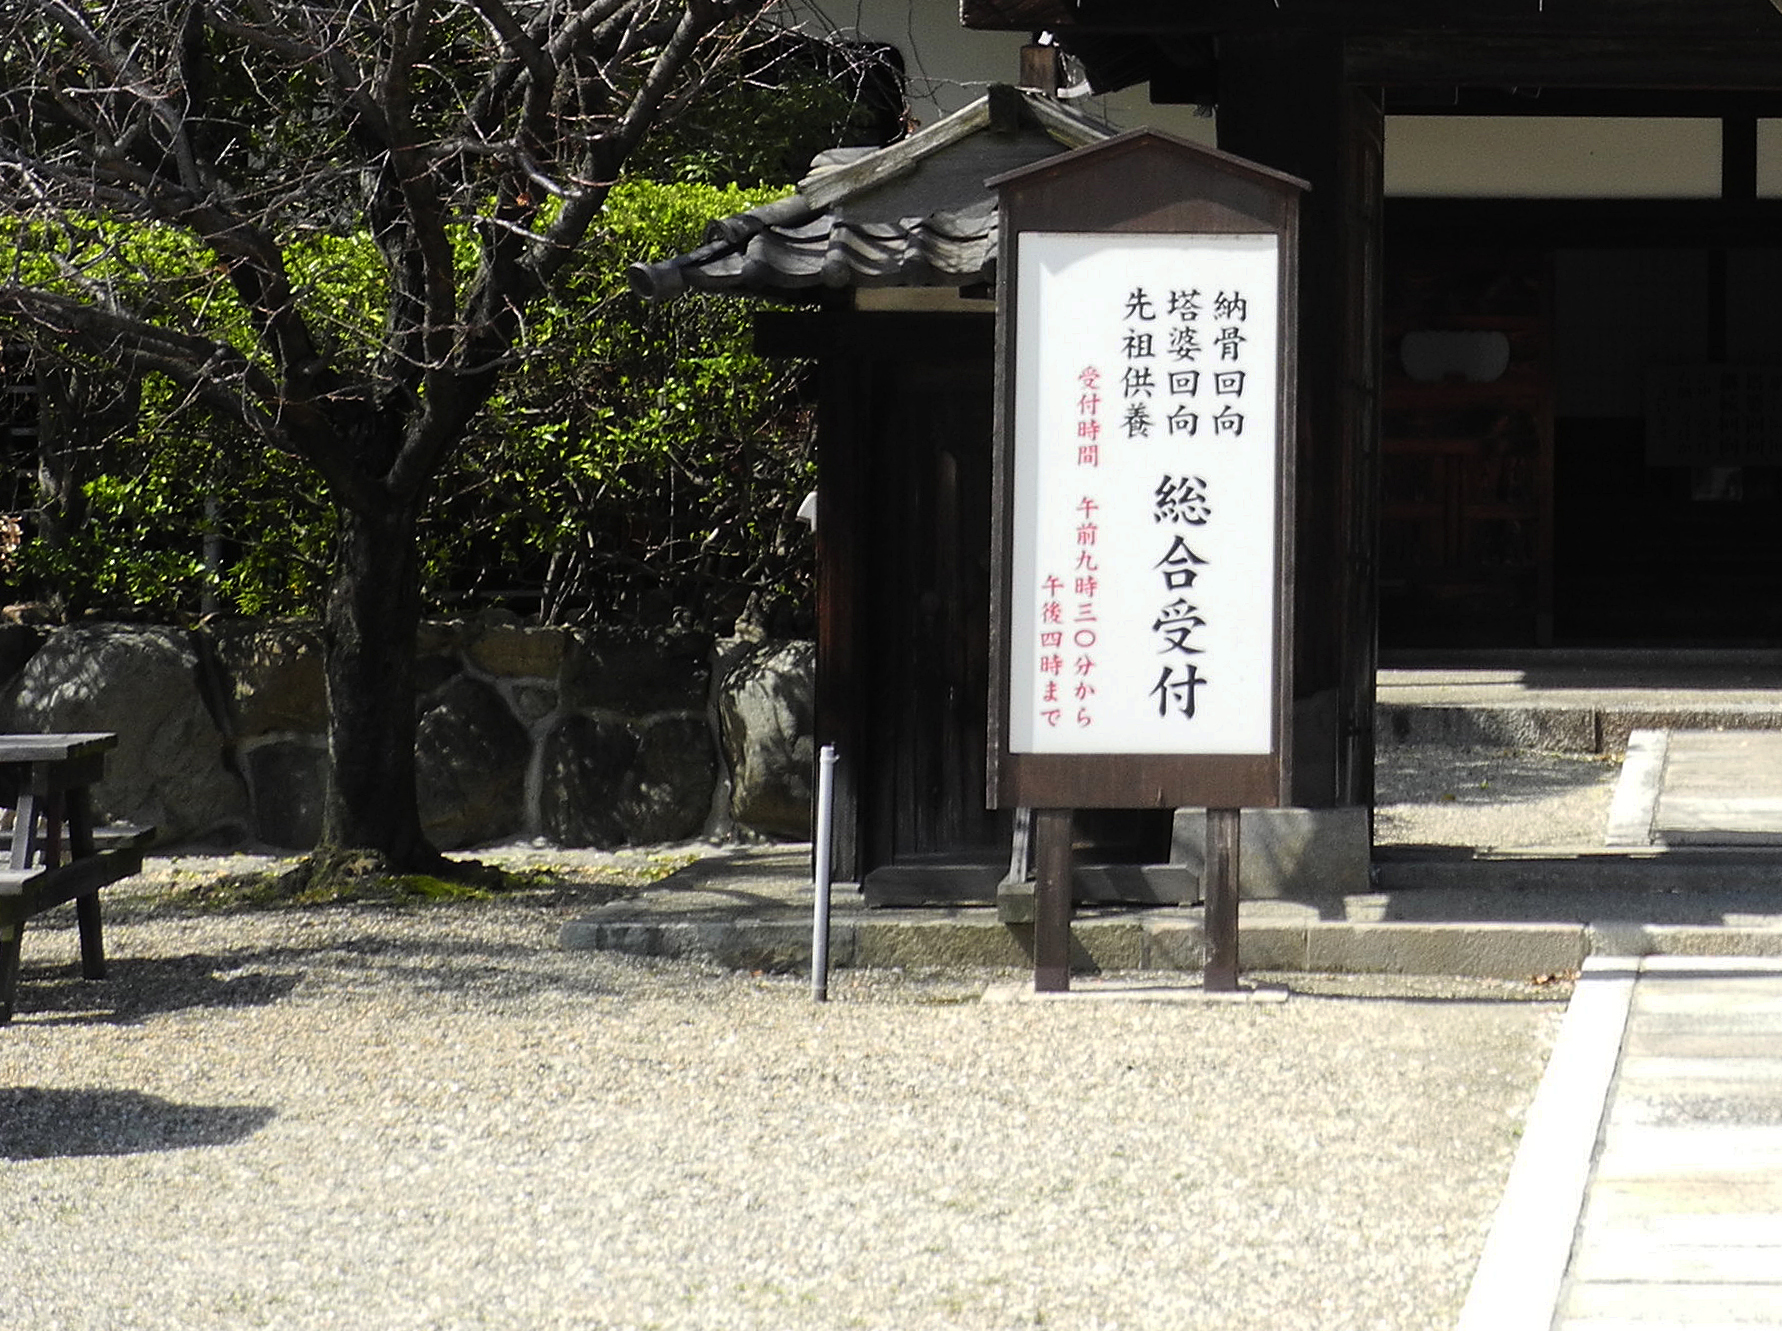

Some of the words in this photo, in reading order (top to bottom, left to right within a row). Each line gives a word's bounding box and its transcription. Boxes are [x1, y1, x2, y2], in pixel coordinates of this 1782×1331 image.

[1077, 368, 1103, 467] 受付時間
[1122, 287, 1156, 438] 先祖供養
[1167, 289, 1201, 436] 塔婆回向
[1213, 291, 1246, 437] 納骨回向
[1039, 575, 1065, 727] 午後四時まで
[1150, 475, 1211, 719] 総合受付
